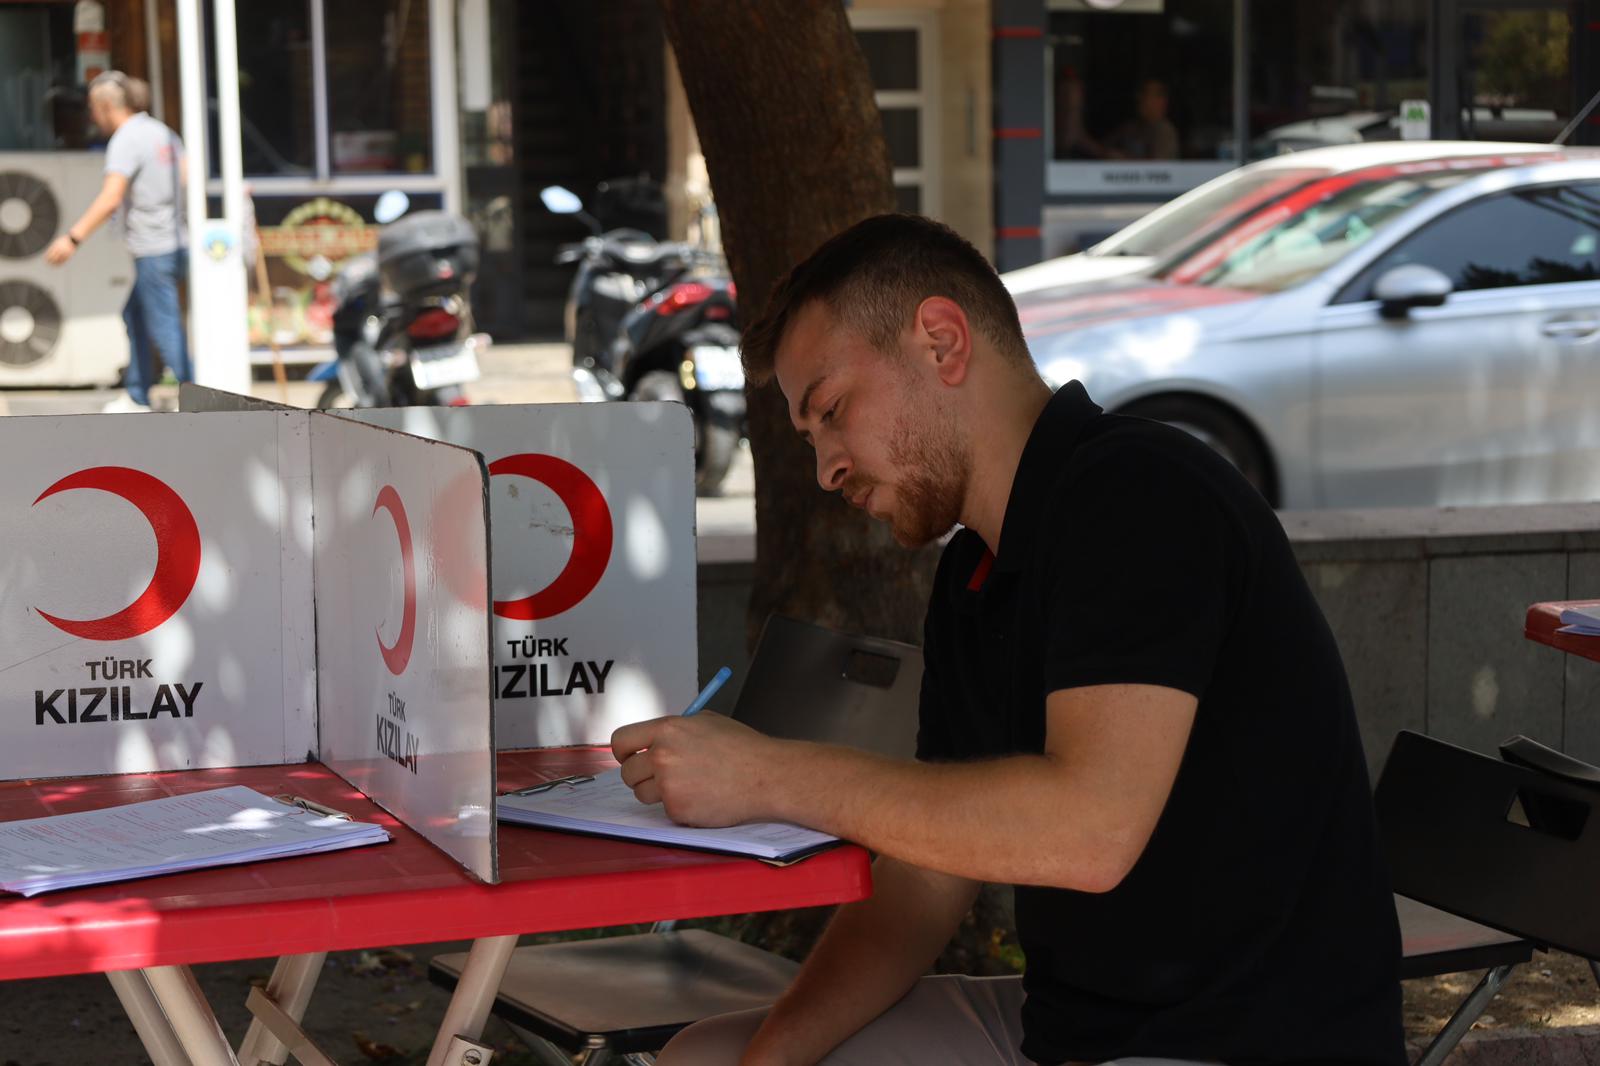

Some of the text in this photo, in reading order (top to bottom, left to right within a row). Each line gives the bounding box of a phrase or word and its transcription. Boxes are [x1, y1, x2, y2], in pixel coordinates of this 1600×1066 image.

[507, 635, 569, 658] TÜRK
[85, 656, 153, 680] TÜRK
[494, 660, 615, 699] IZILAY
[35, 682, 203, 725] KIZILAY
[388, 691, 406, 722] TÜRK
[376, 713, 420, 775] KIZILAY
